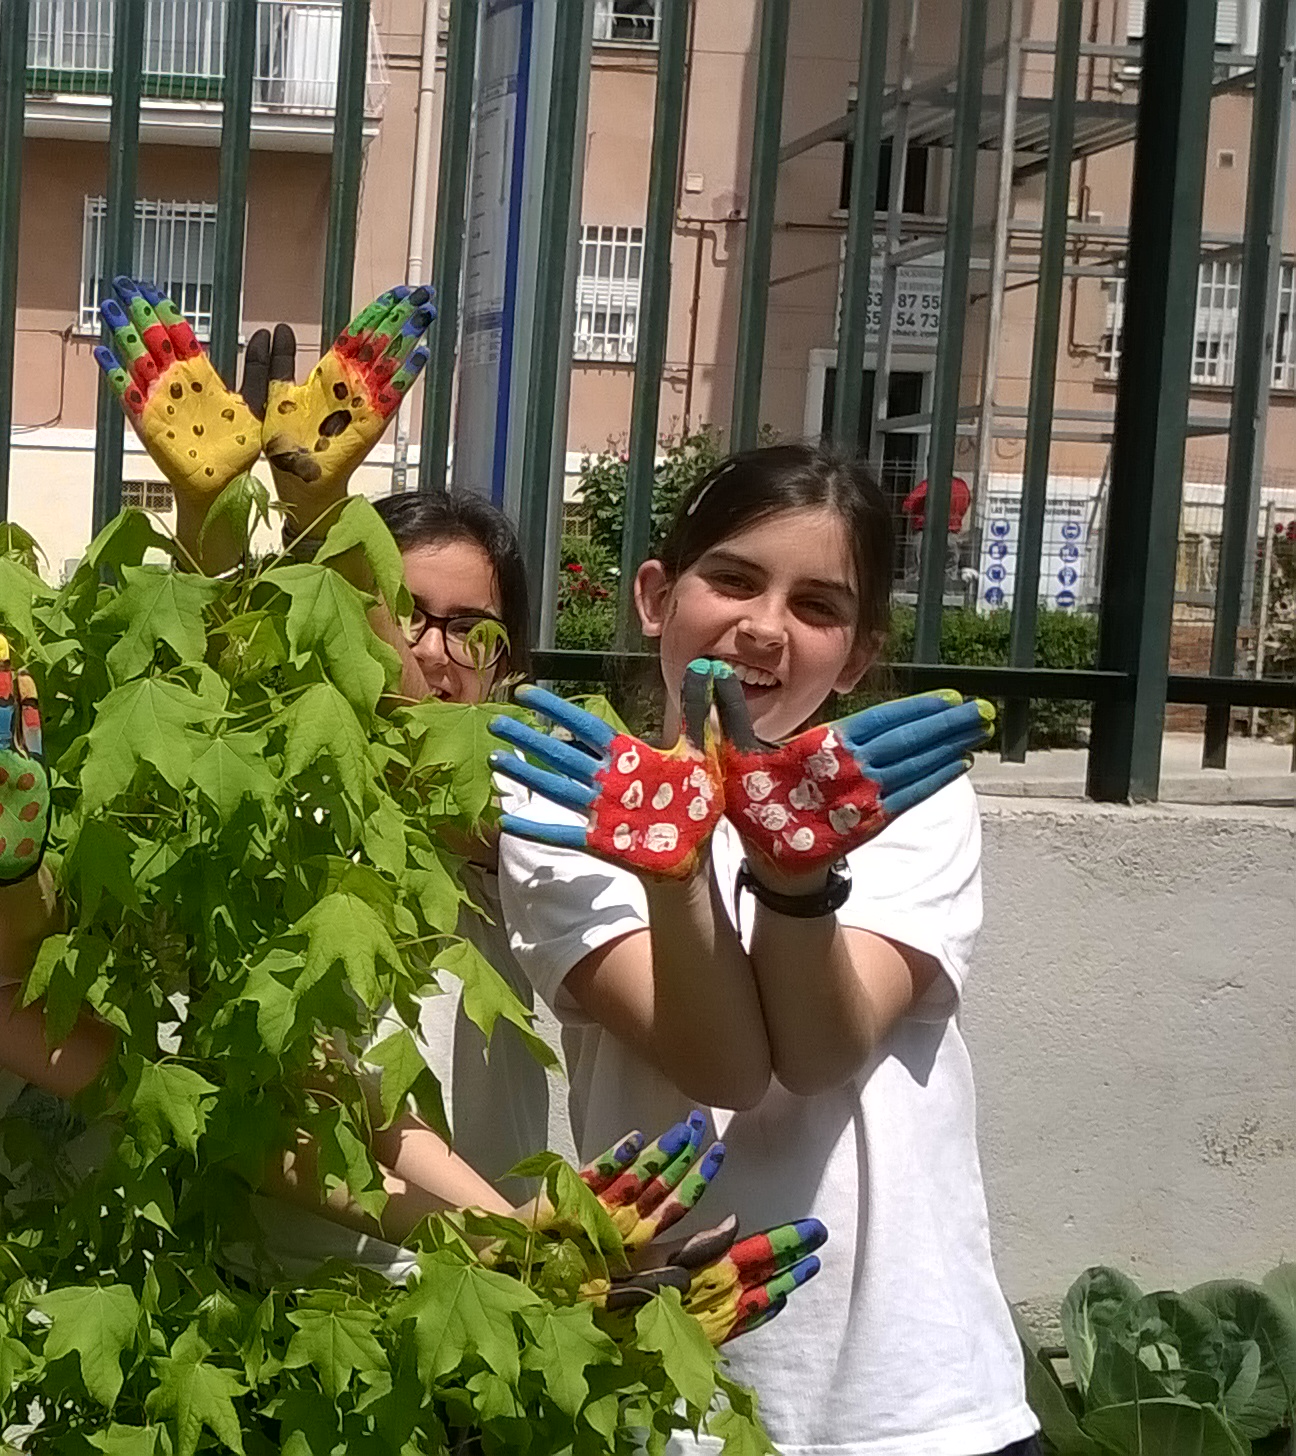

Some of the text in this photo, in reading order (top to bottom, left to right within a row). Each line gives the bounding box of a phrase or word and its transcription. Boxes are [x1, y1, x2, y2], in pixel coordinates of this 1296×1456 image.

[898, 294, 917, 308] 87
[922, 295, 940, 310] 55
[896, 312, 916, 327] 54
[920, 313, 939, 328] 73
